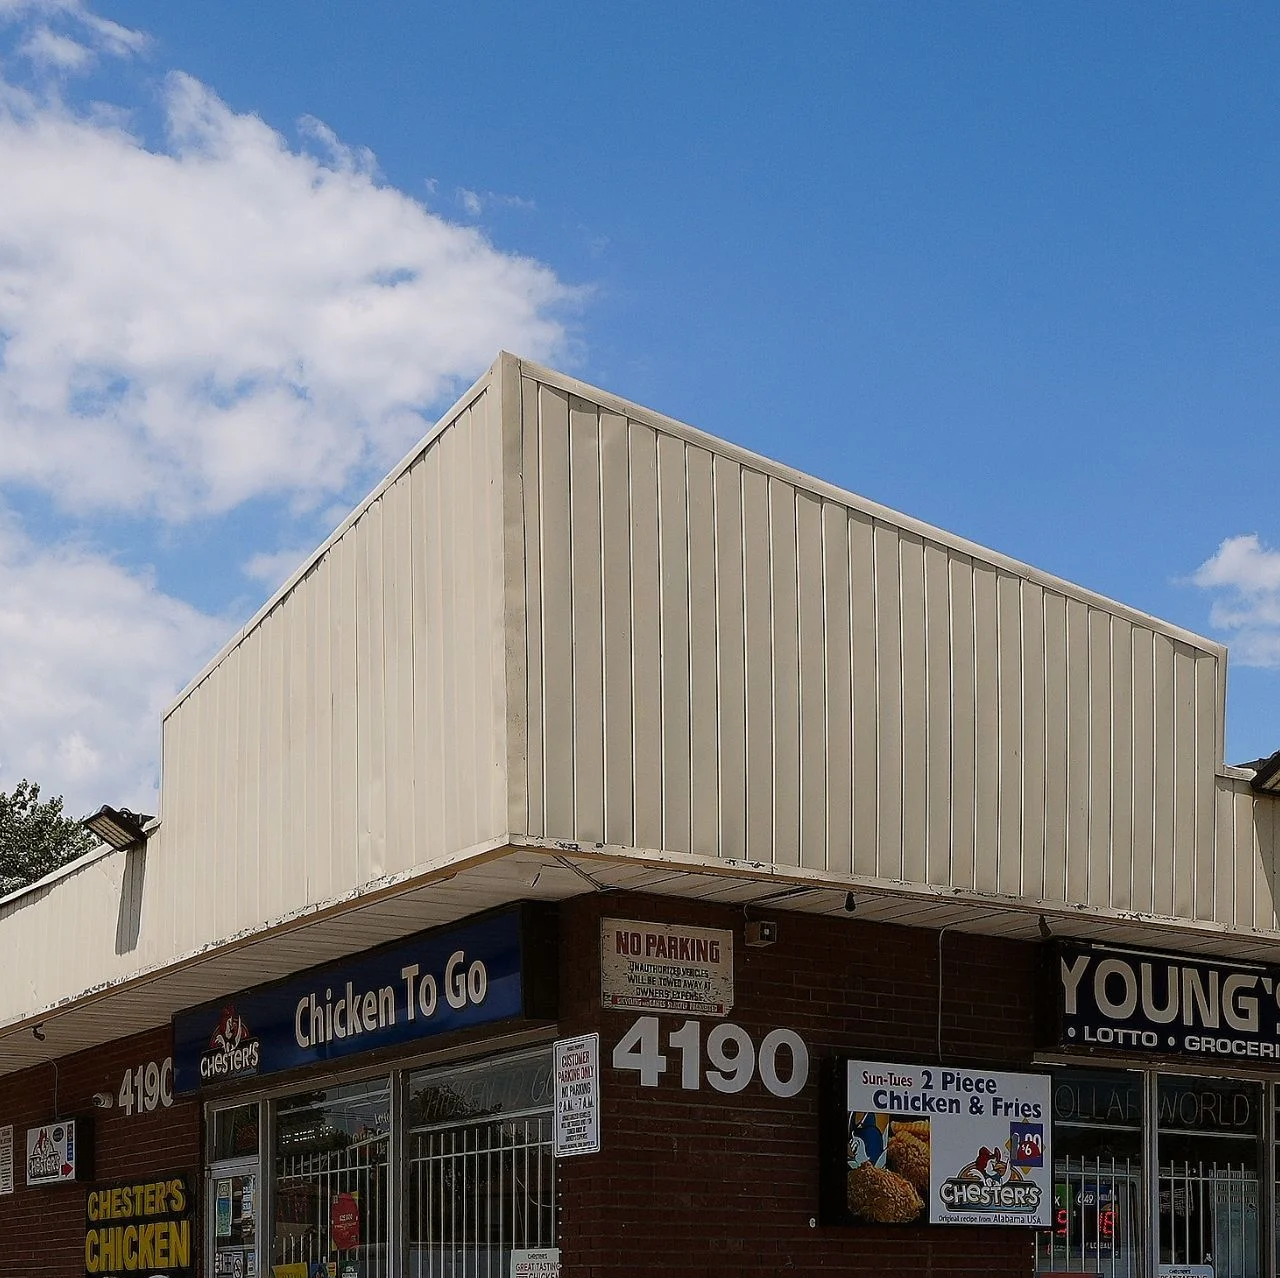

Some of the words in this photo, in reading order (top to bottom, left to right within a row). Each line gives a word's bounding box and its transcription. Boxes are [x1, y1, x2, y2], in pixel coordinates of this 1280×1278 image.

[616, 931, 641, 955] NO
[646, 934, 720, 963] PARKING
[683, 979, 703, 989] AWAY
[295, 981, 395, 1048] Chicken
[401, 963, 437, 1021] To
[444, 950, 487, 1009] Go
[1084, 1026, 1158, 1047] LOTTO
[561, 1051, 590, 1068] CUSTOMER
[612, 1016, 809, 1098] 4190
[558, 1068, 580, 1084] PARKING
[581, 1065, 594, 1080] ONLY
[862, 1070, 913, 1087] Sun-Tues
[921, 1070, 934, 1090] 2
[941, 1071, 997, 1094] Piece
[562, 1086, 569, 1099] NO
[873, 1089, 961, 1114] Chicken
[969, 1095, 985, 1116] &
[992, 1097, 1042, 1118] Fries
[88, 1179, 186, 1222] CHESTER'S
[938, 1215, 960, 1223] Original
[992, 1213, 1025, 1224] Alabama
[1027, 1214, 1042, 1224] USA
[85, 1219, 190, 1273] CHICKEN
[516, 1263, 535, 1272] GREAT
